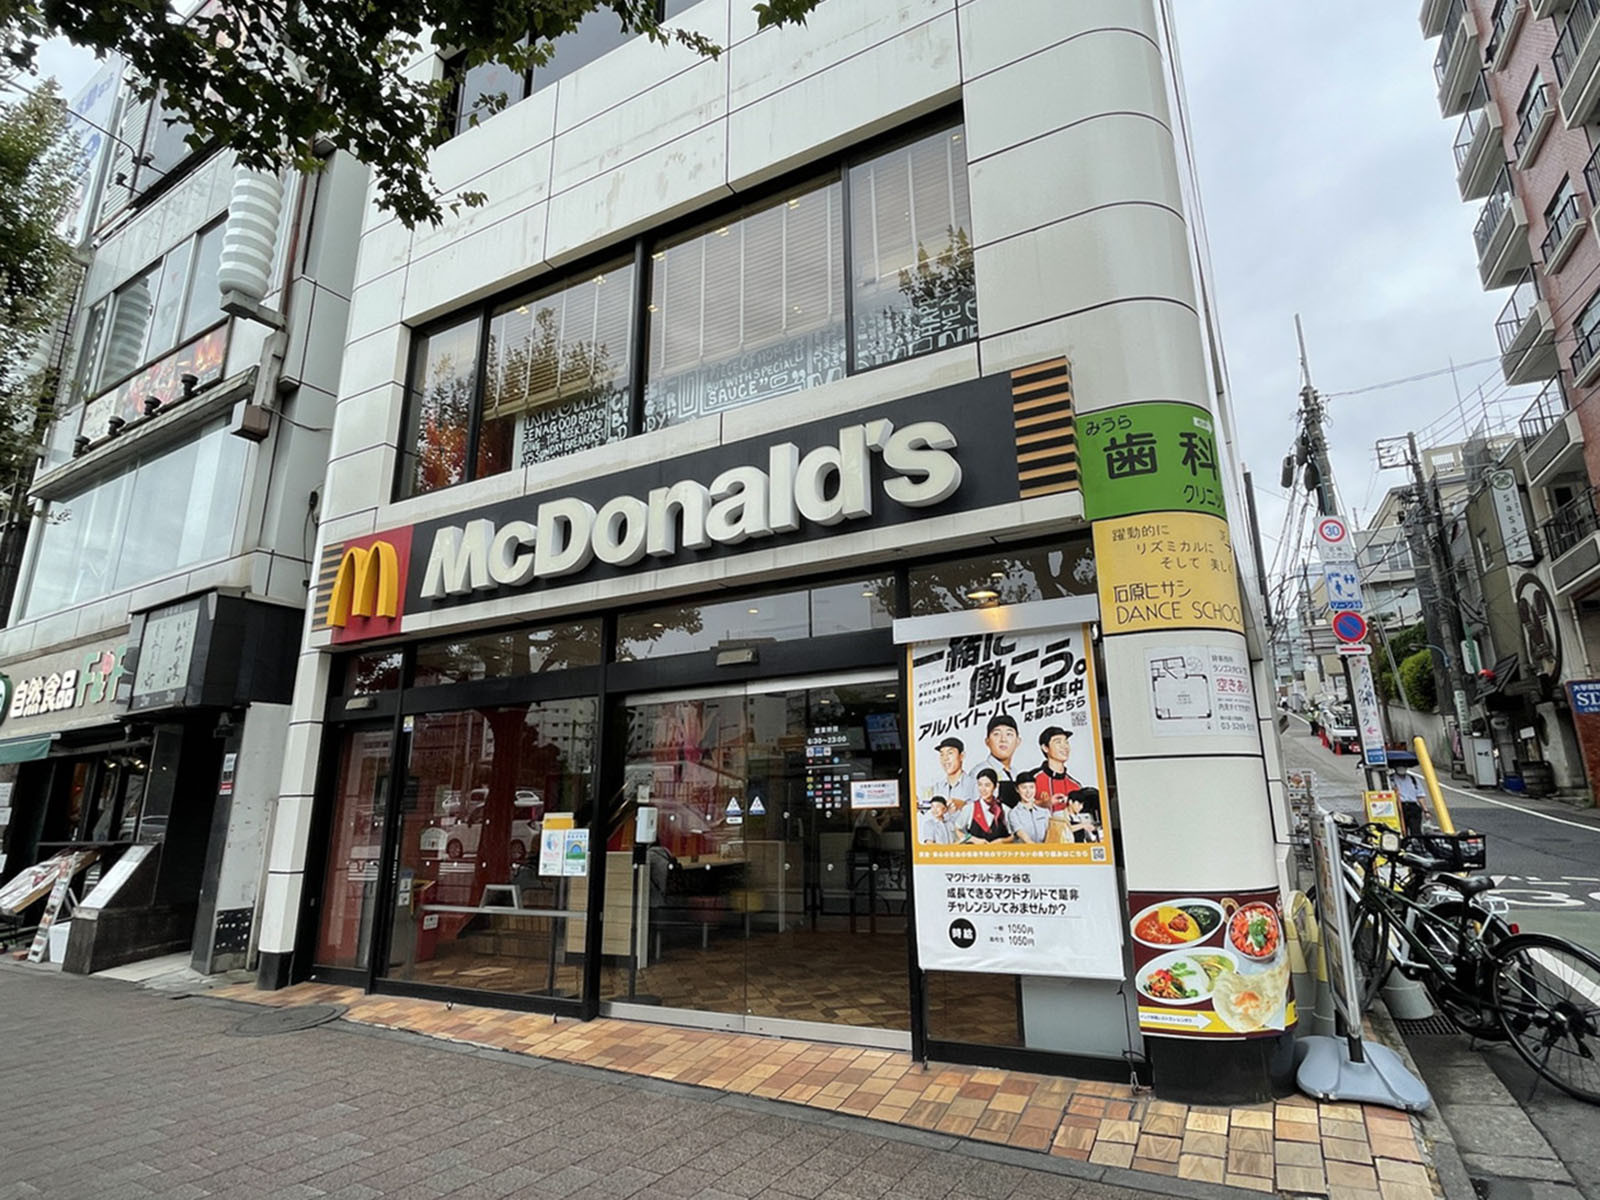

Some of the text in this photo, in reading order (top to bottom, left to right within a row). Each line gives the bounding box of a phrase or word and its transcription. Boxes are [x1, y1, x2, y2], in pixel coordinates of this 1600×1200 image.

[725, 372, 752, 388] WITH
[1085, 414, 1133, 437] みうら
[1103, 431, 1217, 481] 歯科
[419, 417, 963, 600] McDonald's
[1325, 525, 1340, 537] 30
[1136, 540, 1214, 555] リズミカルに
[1160, 556, 1200, 570] そして
[1113, 579, 1192, 604] 石原ヒサシ
[1116, 601, 1184, 625] DANCE
[968, 637, 1088, 708] 働こう。
[9, 669, 79, 718] 自然食品
[1023, 695, 1087, 724] 応募はこちら
[946, 887, 1080, 901] 成長できるマクドナルドで是非
